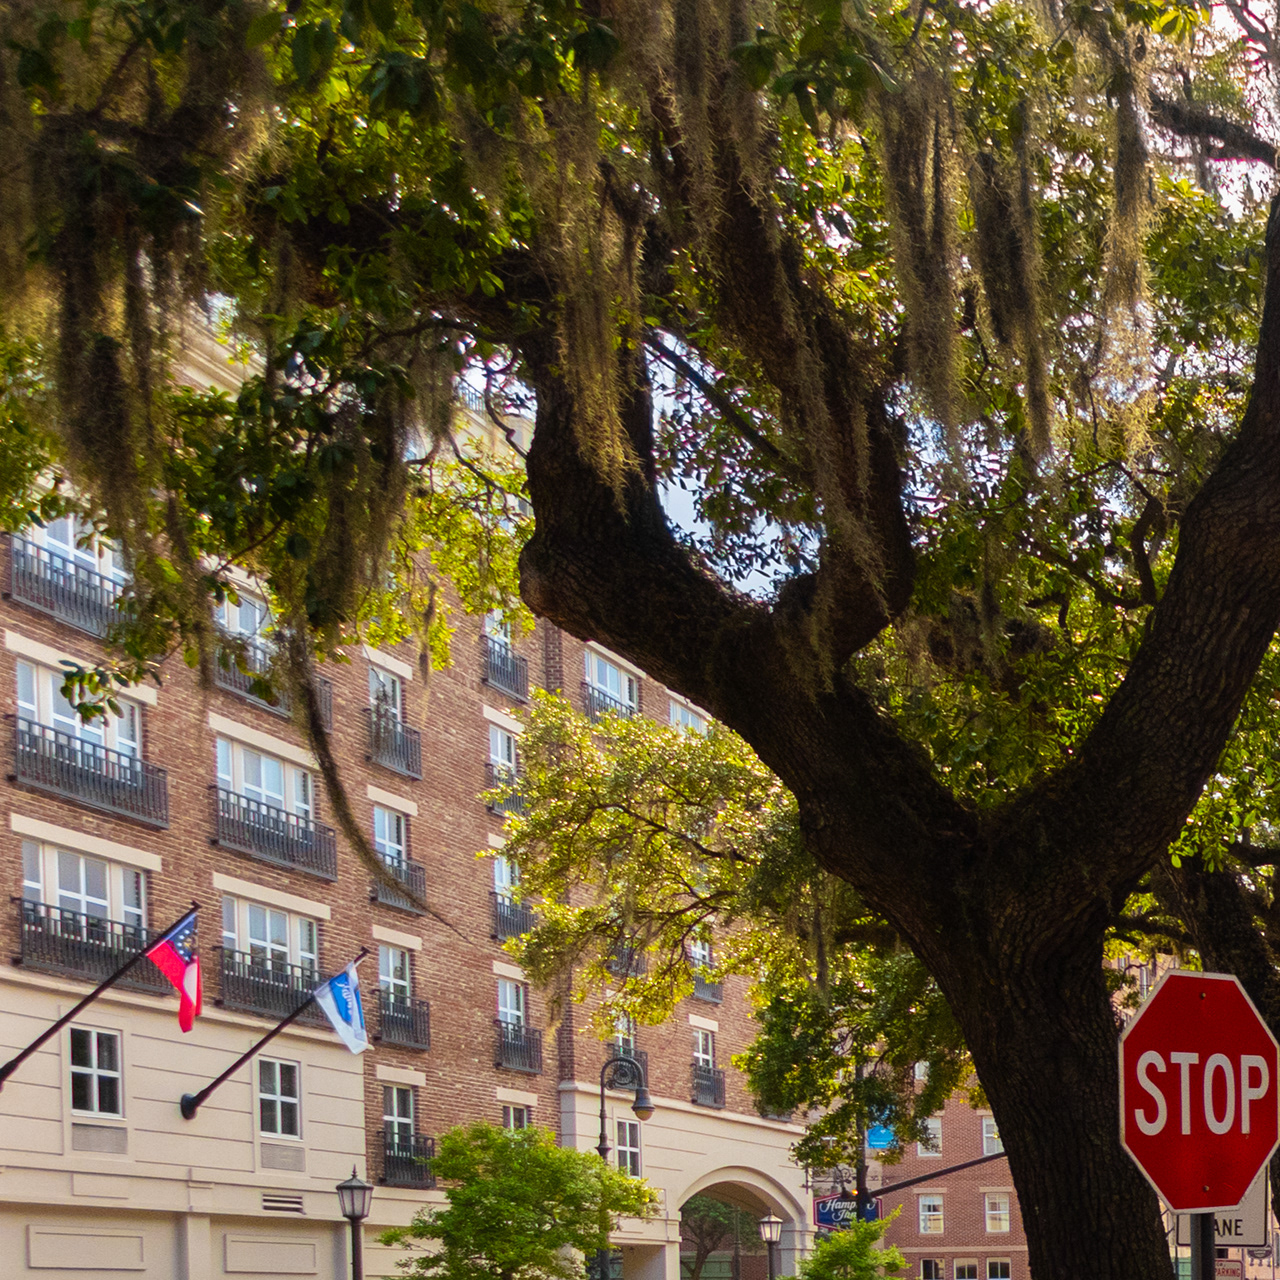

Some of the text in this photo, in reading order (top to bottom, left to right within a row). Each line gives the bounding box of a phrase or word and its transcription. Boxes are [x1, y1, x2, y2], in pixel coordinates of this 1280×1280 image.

[1134, 1050, 1270, 1136] STOP
[819, 1199, 876, 1213] Hamp
[1214, 1219, 1243, 1236] ANE
